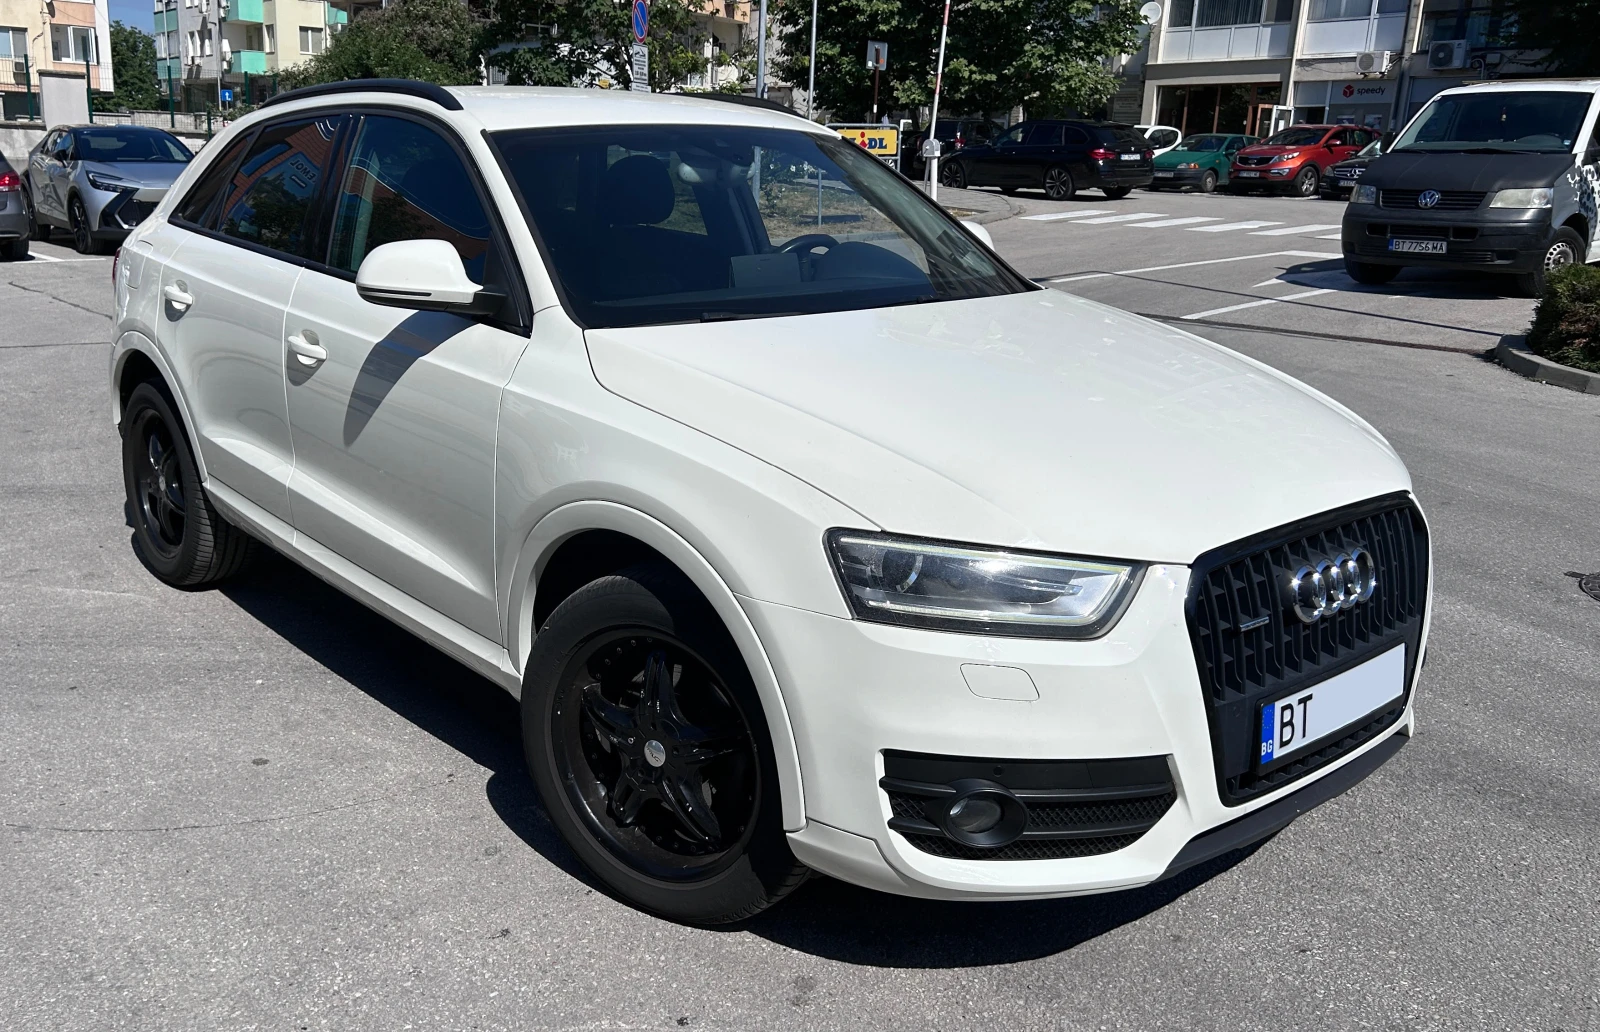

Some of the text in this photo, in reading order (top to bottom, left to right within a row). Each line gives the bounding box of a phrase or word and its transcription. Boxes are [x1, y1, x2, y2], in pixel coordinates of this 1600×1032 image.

[1356, 86, 1386, 95] speedy
[849, 131, 887, 149] iDL
[1394, 240, 1407, 250] BT
[1408, 241, 1431, 252] 7756
[1432, 242, 1444, 253] MA
[1279, 693, 1313, 750] BT
[1261, 739, 1273, 756] BG
